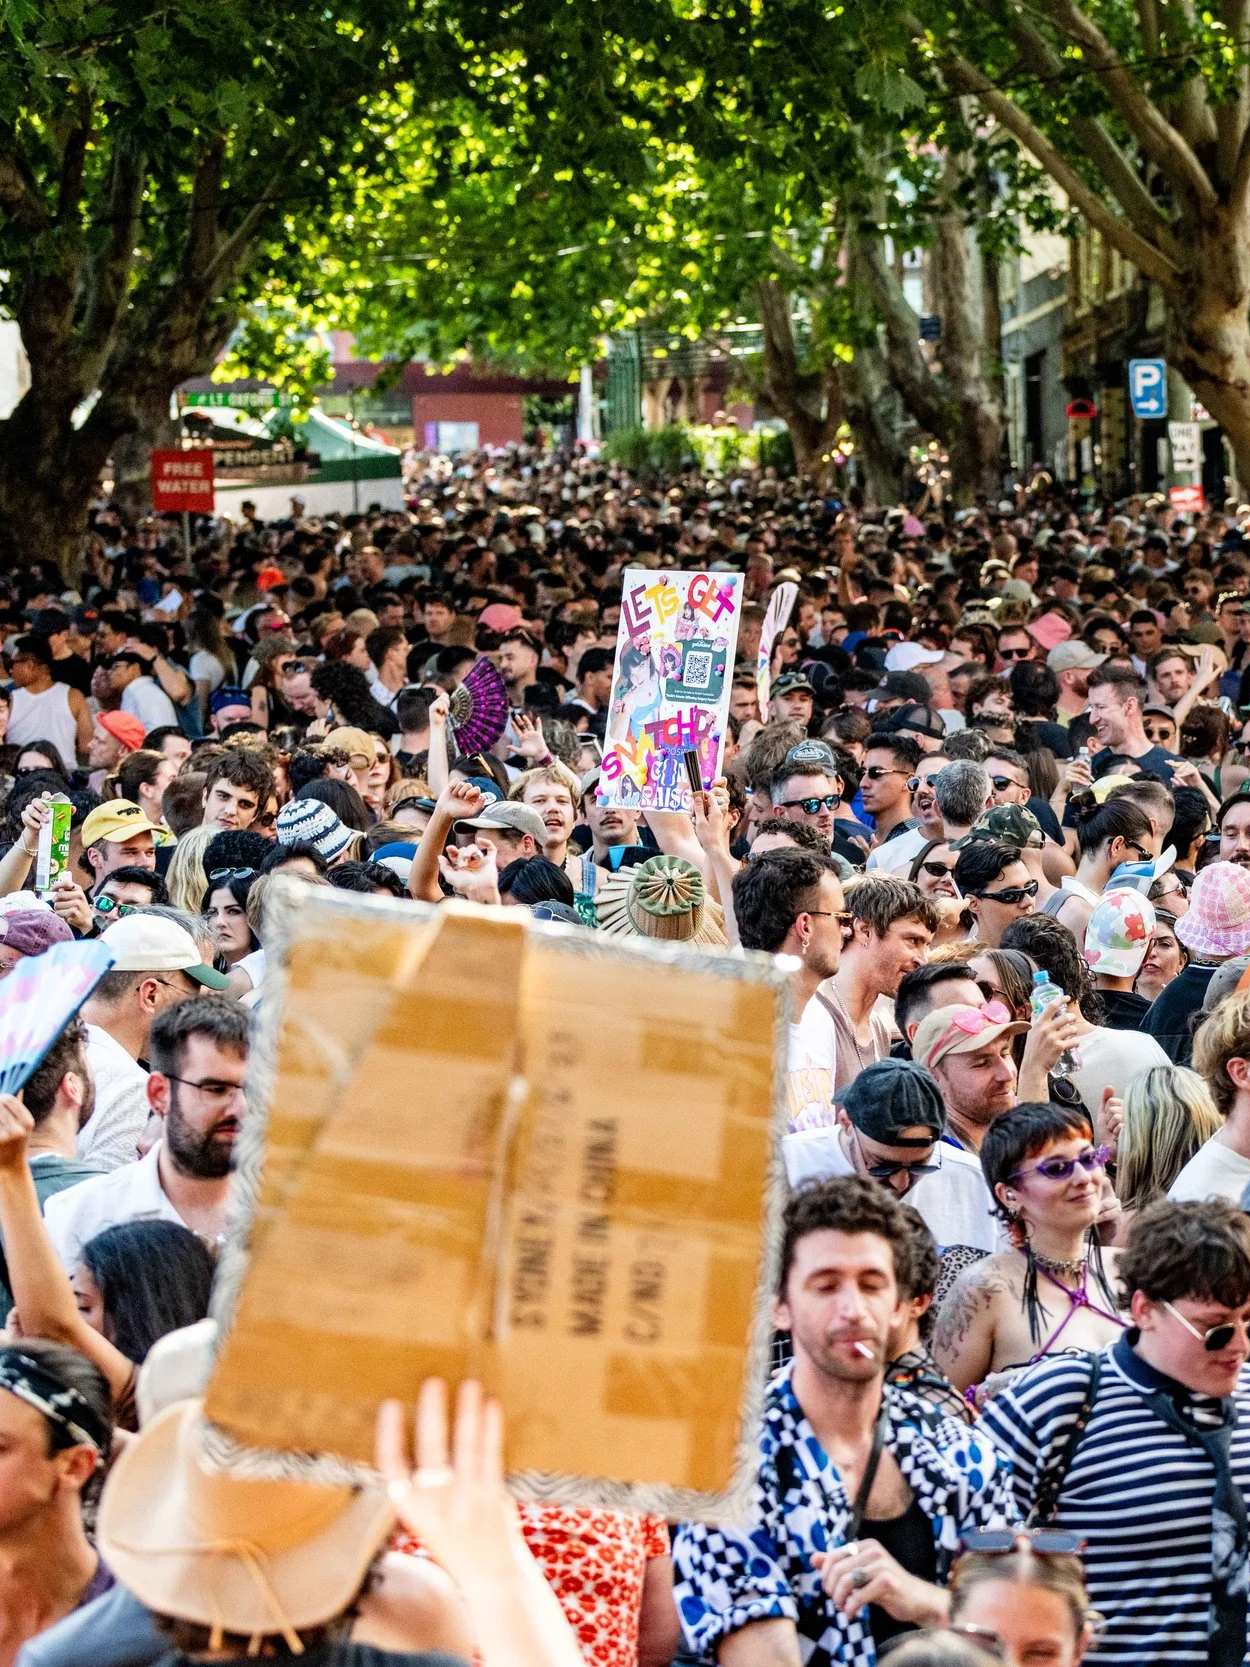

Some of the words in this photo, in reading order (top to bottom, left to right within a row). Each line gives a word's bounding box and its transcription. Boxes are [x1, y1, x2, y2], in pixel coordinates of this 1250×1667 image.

[1134, 366, 1161, 397] P
[157, 479, 211, 493] WATER
[162, 462, 204, 477] FREE
[687, 574, 736, 623] GET
[578, 1117, 618, 1204] CHINA
[576, 1213, 611, 1246] IN
[569, 1256, 611, 1339] MADE
